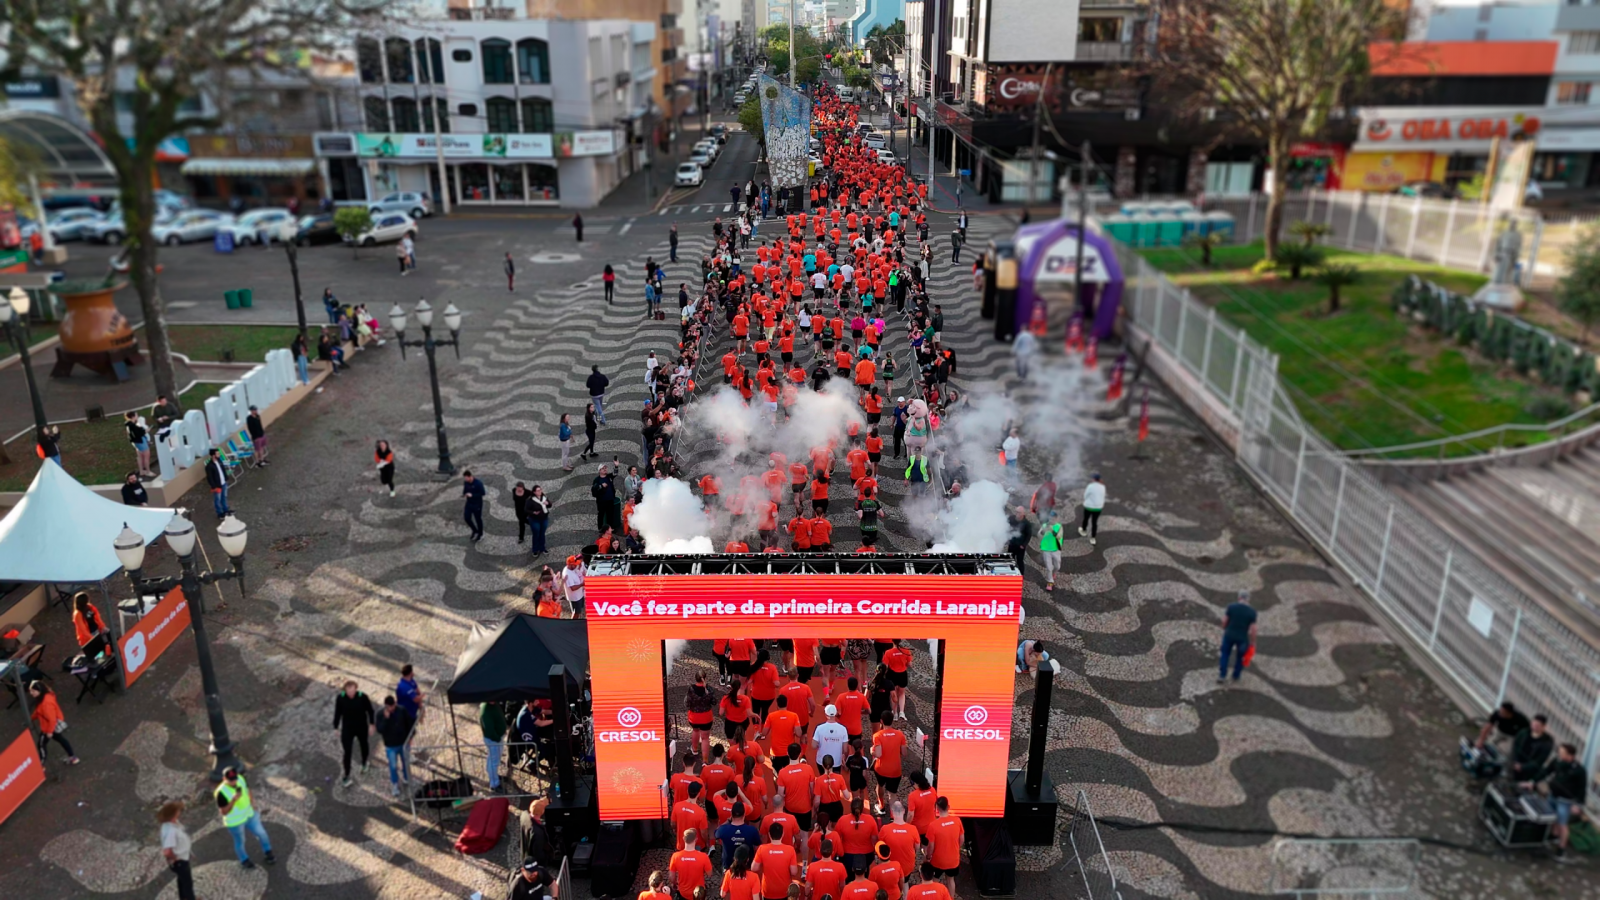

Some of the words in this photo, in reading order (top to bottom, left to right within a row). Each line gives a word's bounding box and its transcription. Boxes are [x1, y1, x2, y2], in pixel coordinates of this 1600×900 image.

[1402, 118, 1453, 141] OBA
[1459, 117, 1509, 140] OBA
[592, 600, 643, 616] Você
[647, 601, 678, 615] fez
[683, 601, 736, 618] parte
[740, 600, 765, 615] da
[769, 599, 853, 618] primeira
[857, 599, 932, 615] Corrida
[936, 599, 1015, 618] Laranja!
[599, 730, 660, 743] CRESOL
[943, 727, 1005, 741] CRESOL
